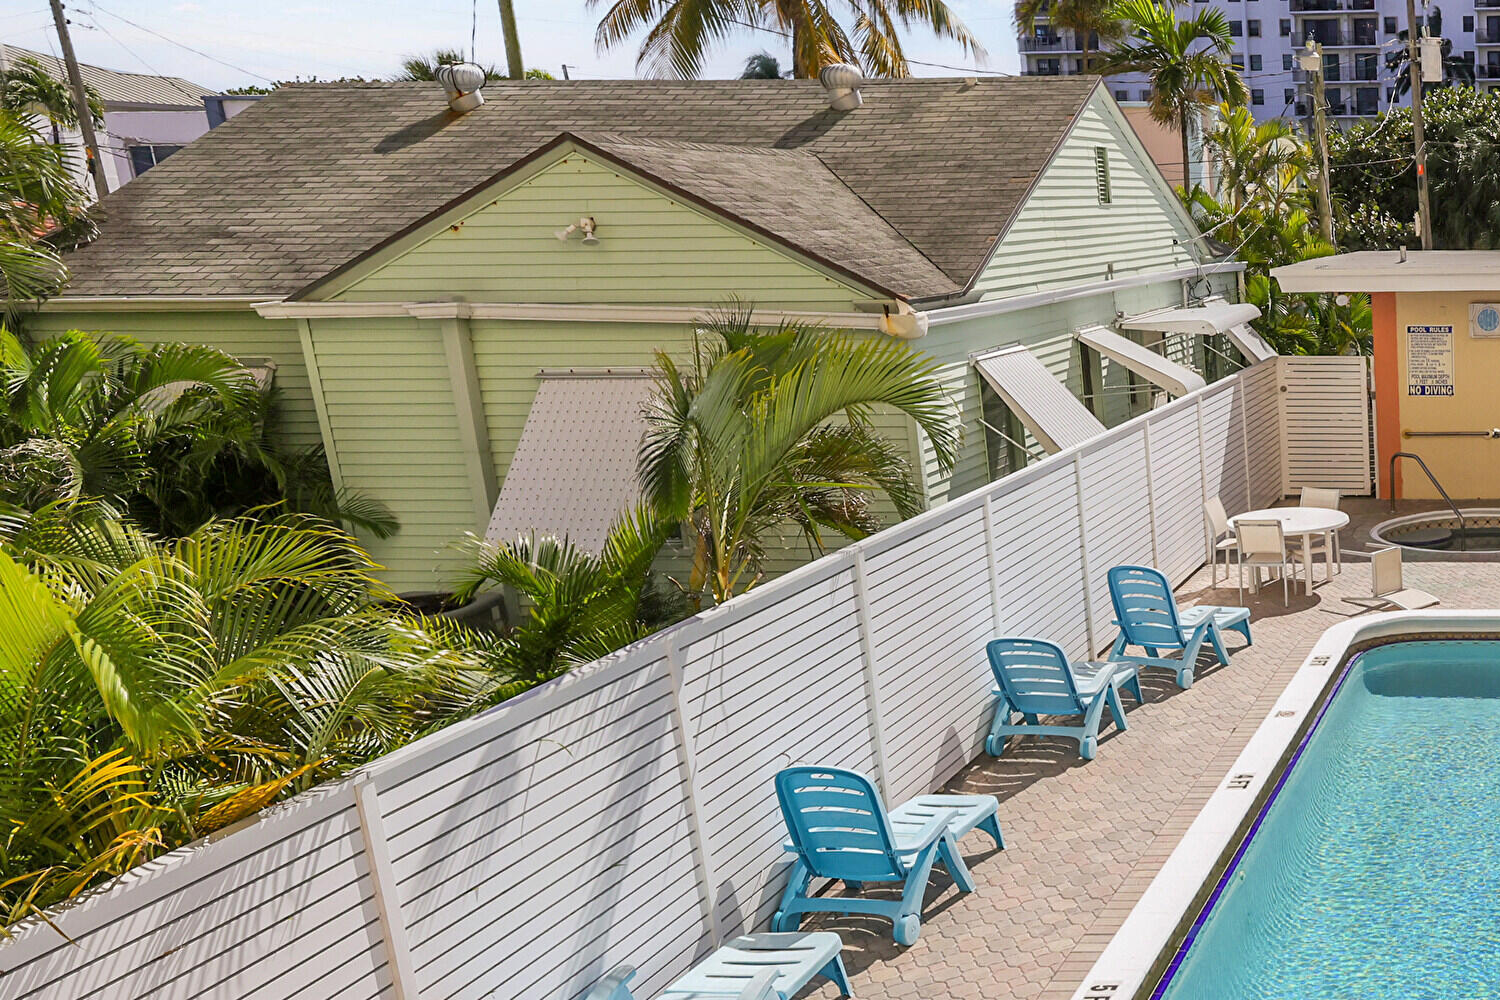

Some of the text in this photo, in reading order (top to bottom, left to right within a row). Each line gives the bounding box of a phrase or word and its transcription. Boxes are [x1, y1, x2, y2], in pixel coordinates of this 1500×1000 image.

[1410, 385, 1453, 395] NO DIVING
[1226, 780, 1250, 789] FT
